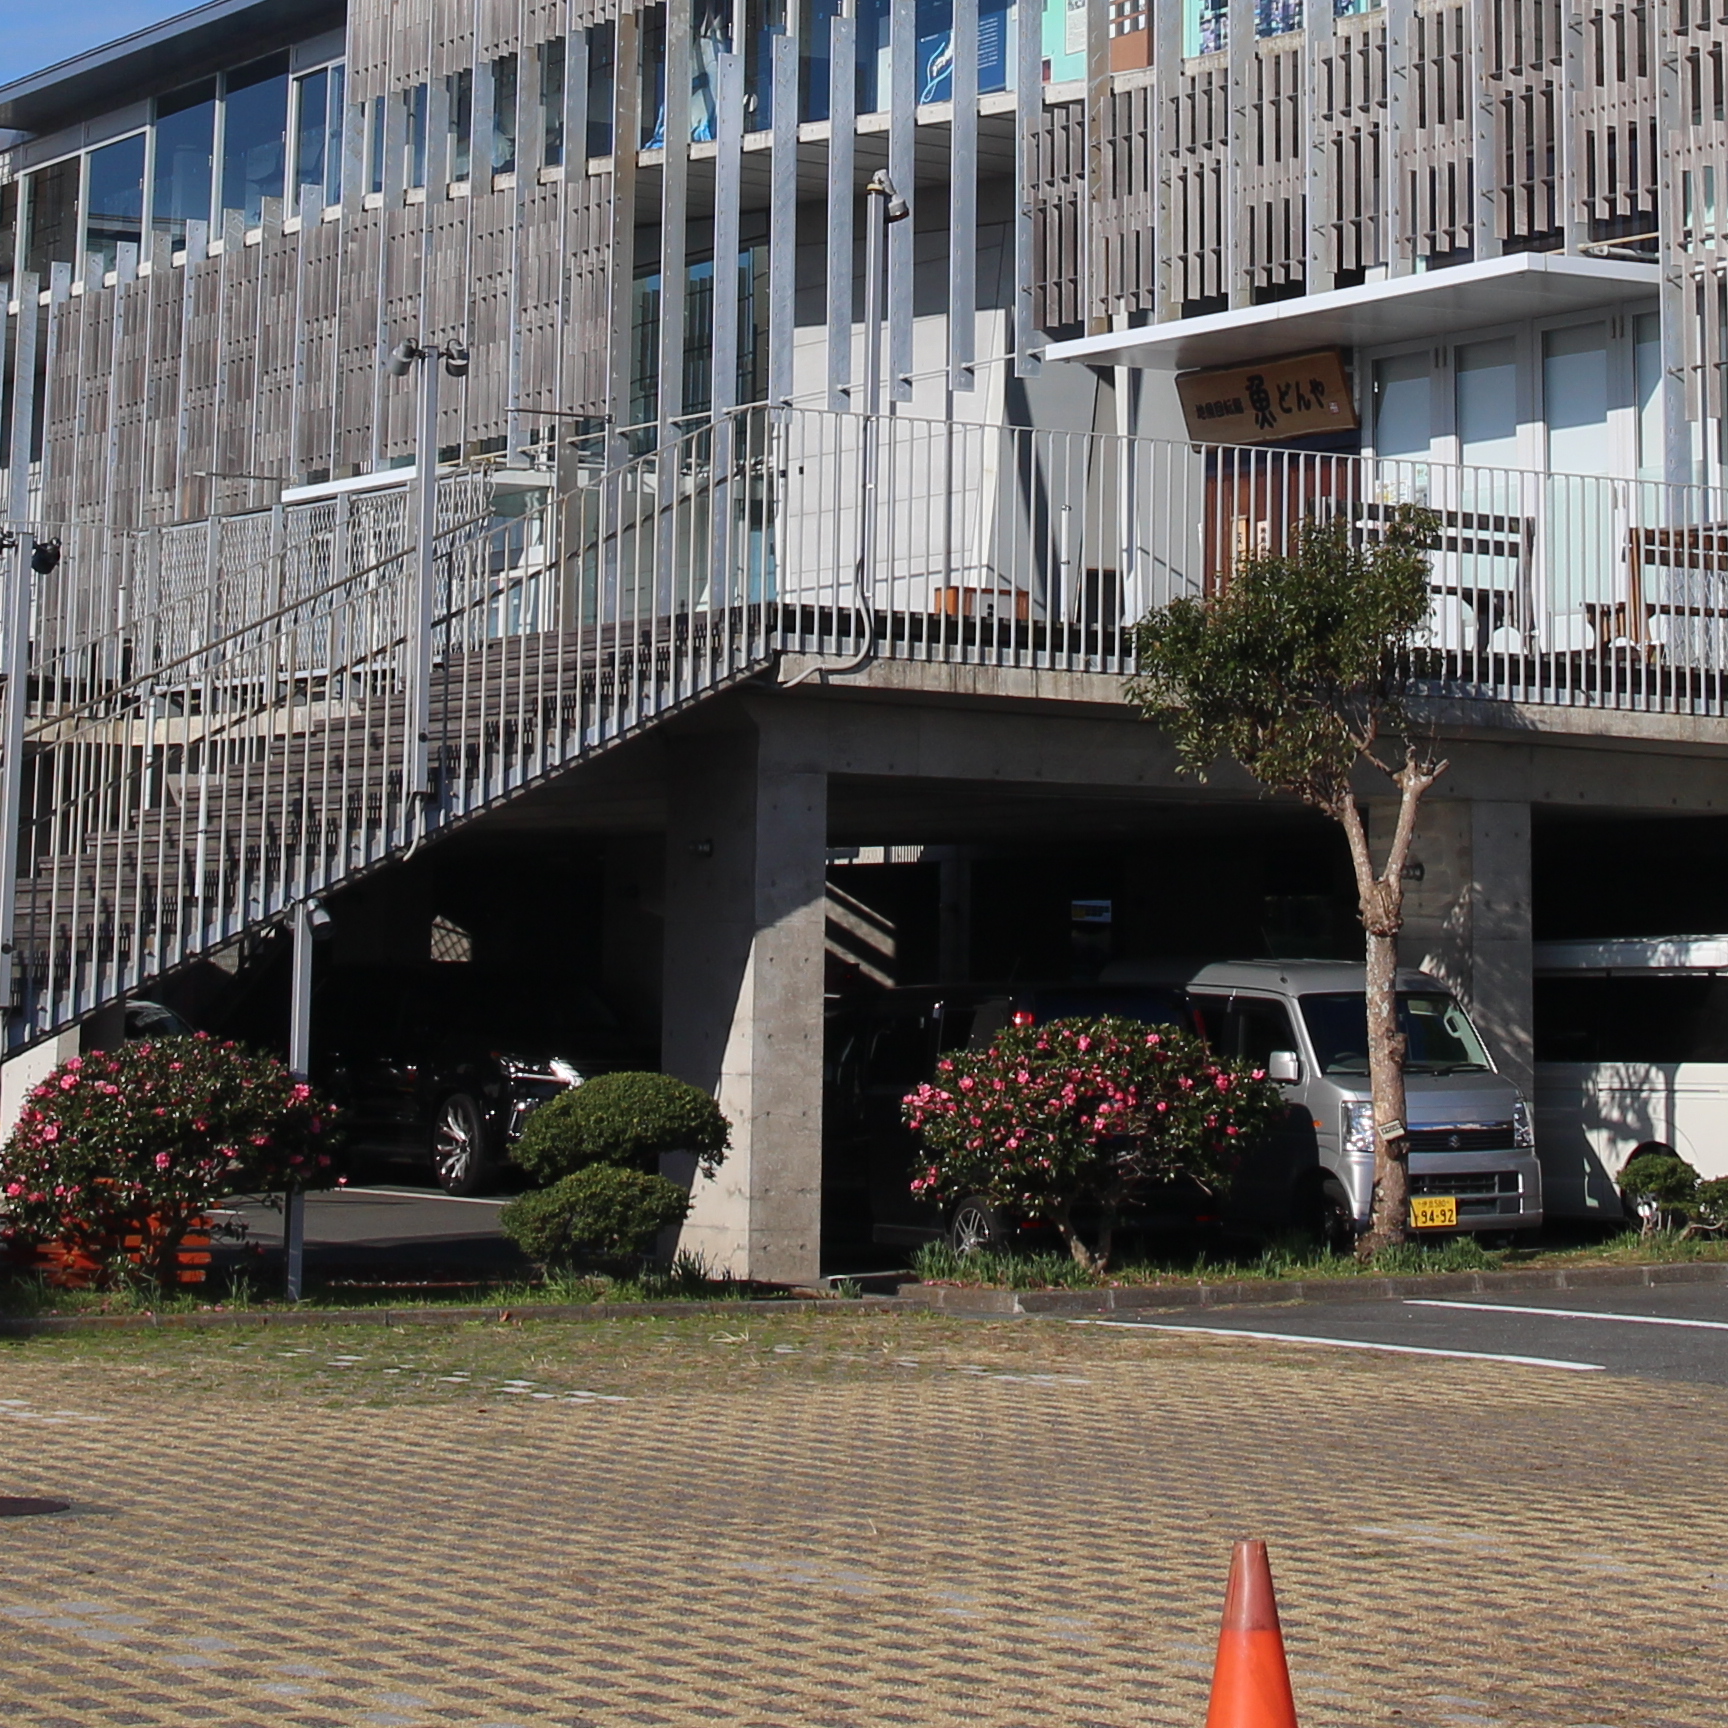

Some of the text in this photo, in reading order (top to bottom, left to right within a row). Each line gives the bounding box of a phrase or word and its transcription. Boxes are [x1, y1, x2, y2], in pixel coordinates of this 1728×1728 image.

[1245, 373, 1326, 430] 魚どんや
[1421, 1208, 1454, 1224] 94-92
